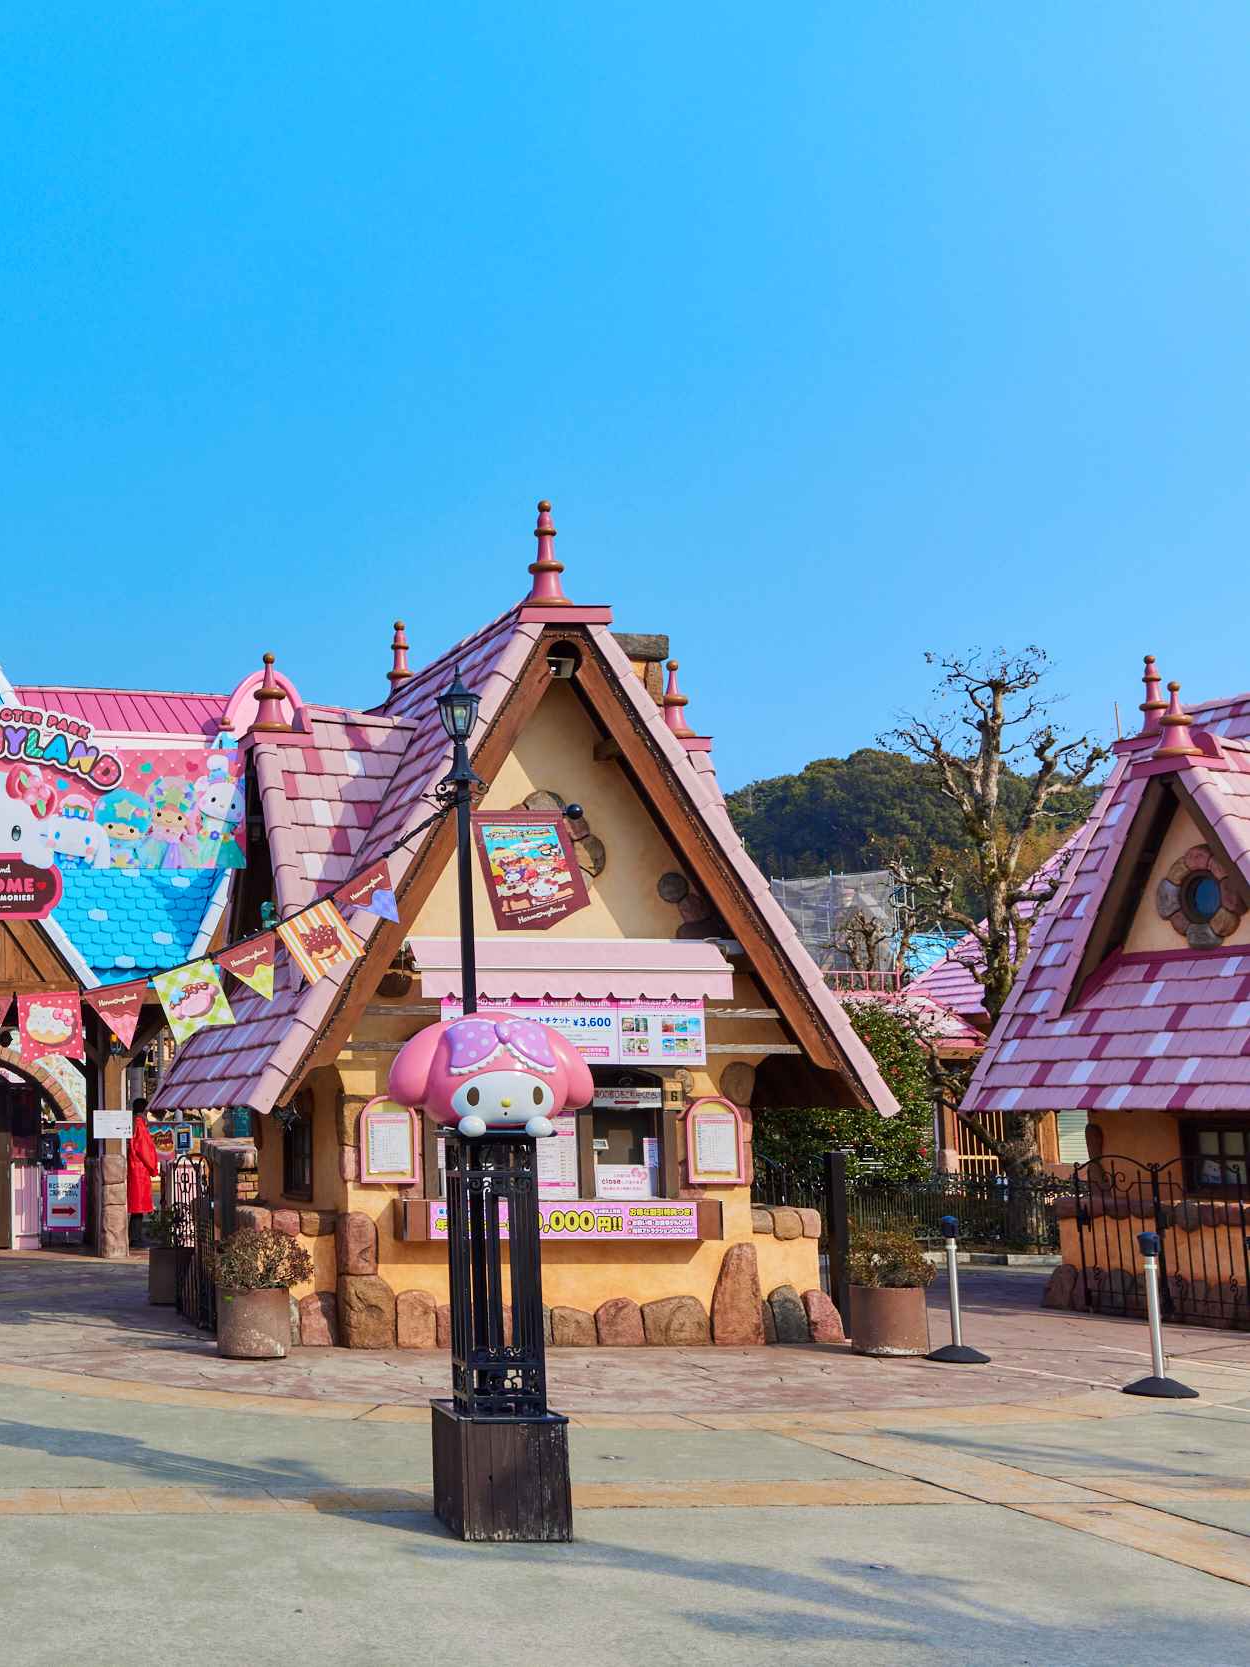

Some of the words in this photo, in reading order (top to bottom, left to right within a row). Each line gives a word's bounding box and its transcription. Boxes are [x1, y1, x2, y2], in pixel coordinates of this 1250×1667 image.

[46, 715, 91, 740] PARK
[573, 1017, 612, 1028] ¥3,600
[670, 1090, 678, 1102] 6
